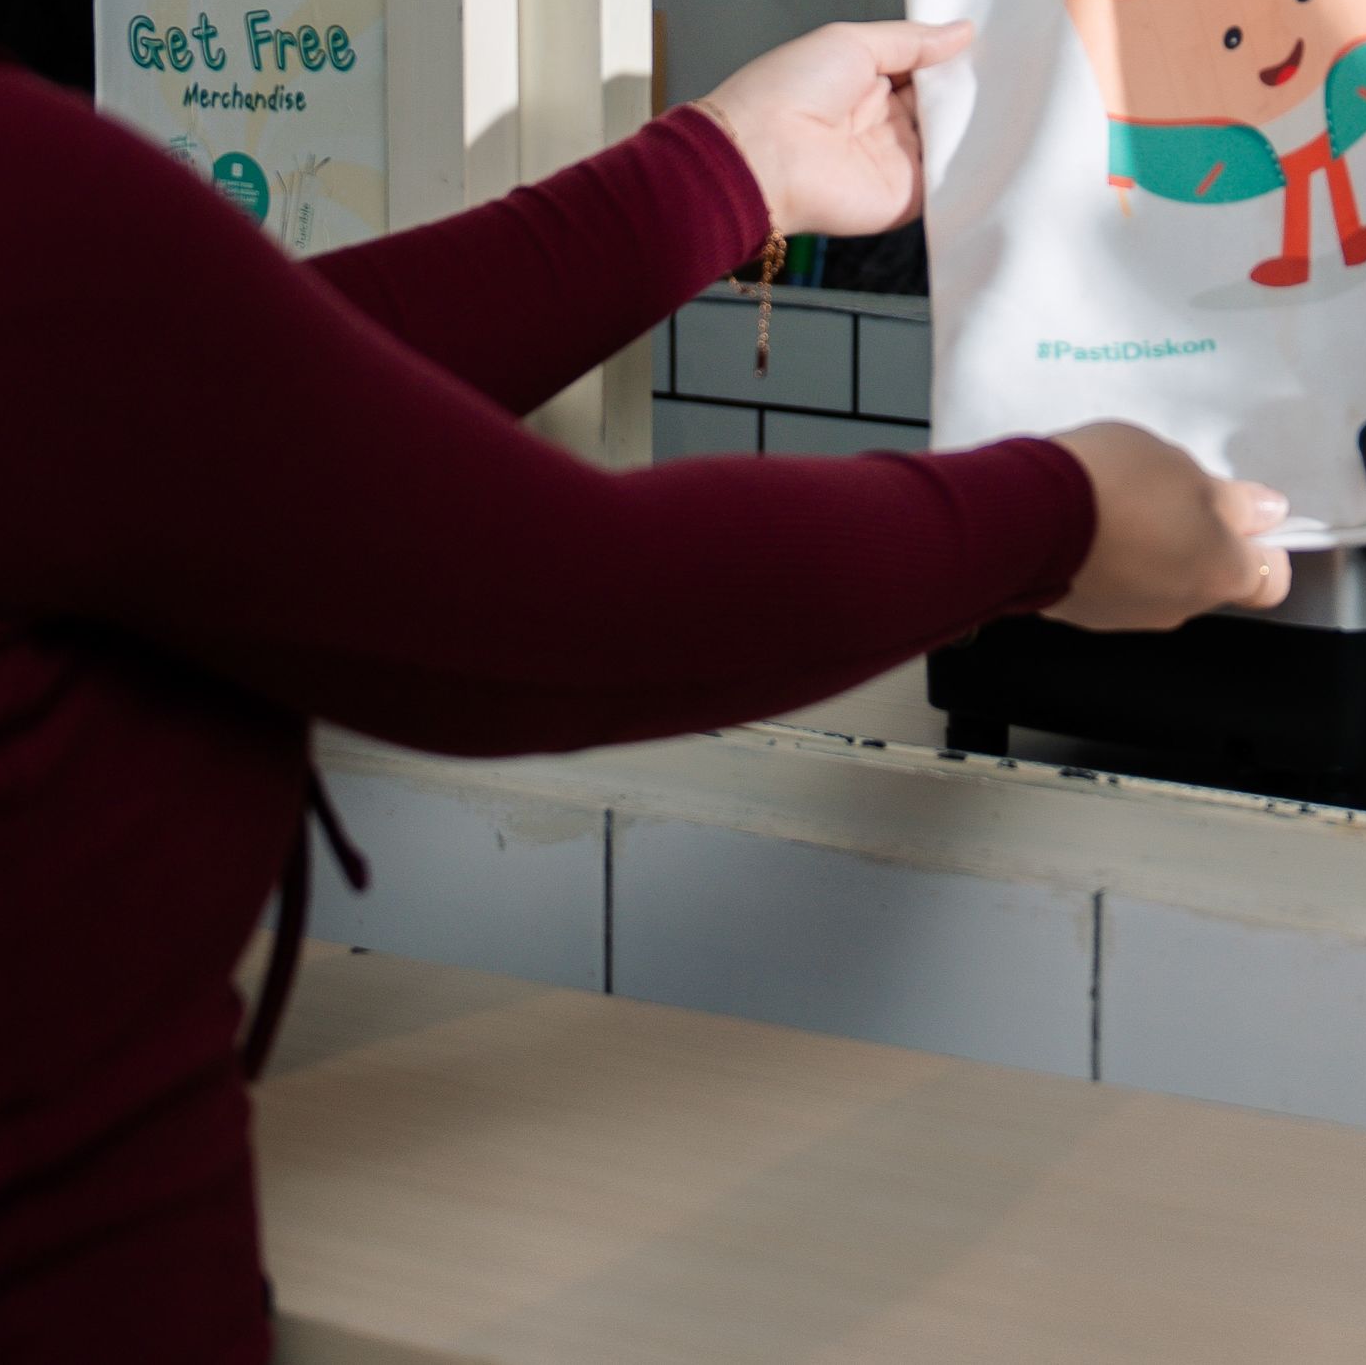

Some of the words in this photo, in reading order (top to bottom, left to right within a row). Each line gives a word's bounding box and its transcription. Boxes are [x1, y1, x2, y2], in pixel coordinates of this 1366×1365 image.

[129, 11, 225, 72] Get
[244, 9, 356, 72] Free
[182, 81, 307, 112] Merchandise
[1036, 337, 1217, 361] #PastiDiskon
